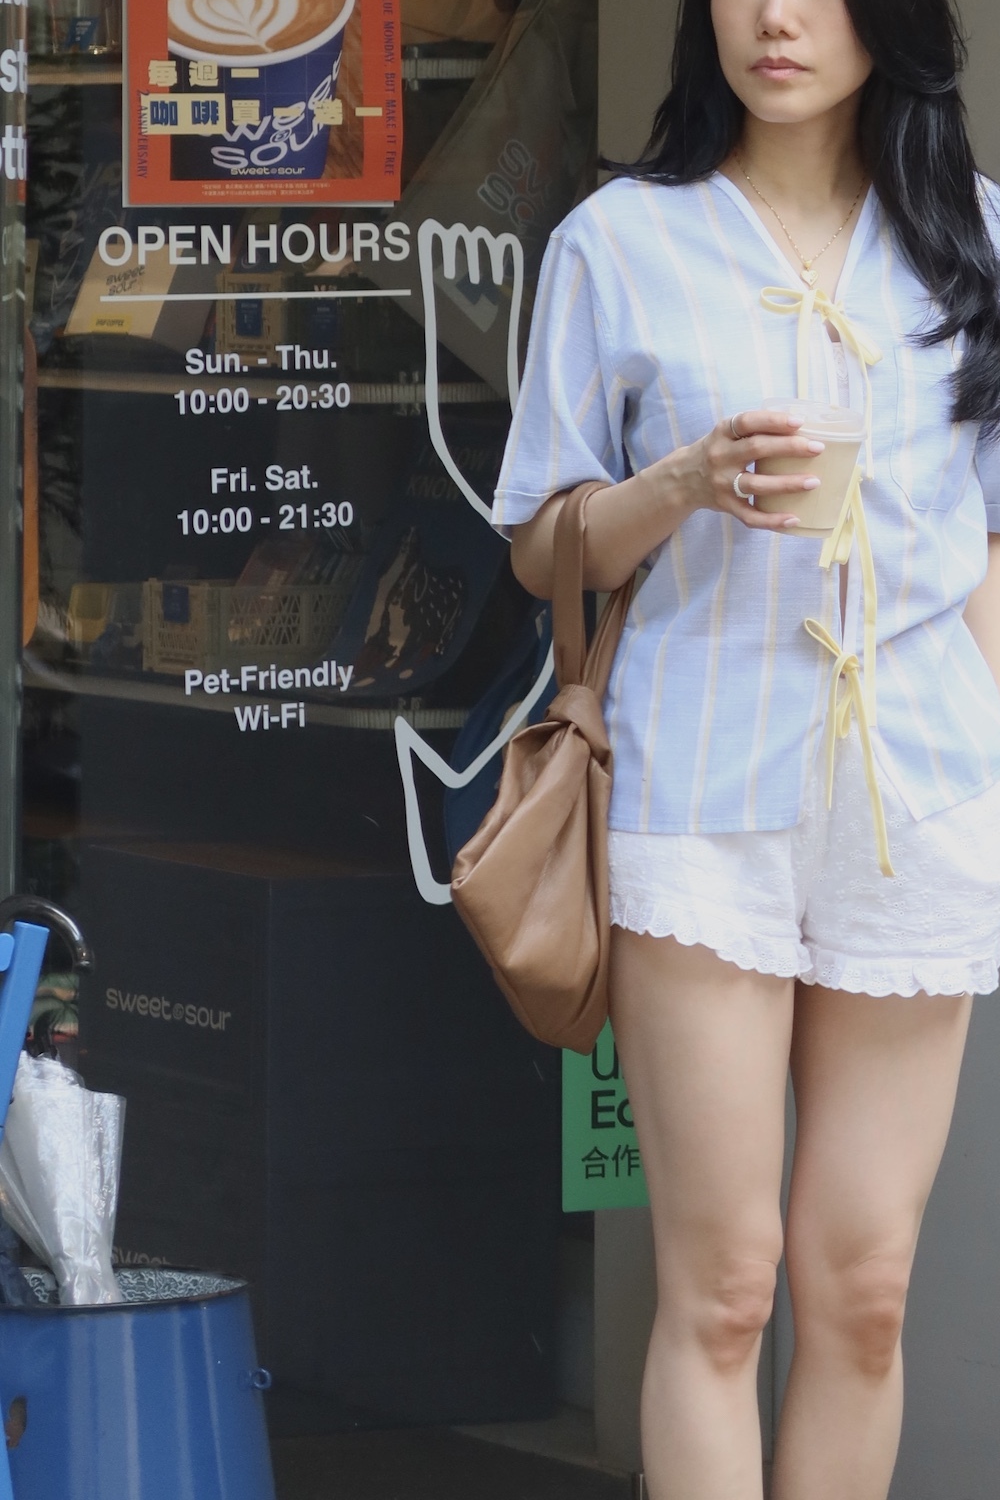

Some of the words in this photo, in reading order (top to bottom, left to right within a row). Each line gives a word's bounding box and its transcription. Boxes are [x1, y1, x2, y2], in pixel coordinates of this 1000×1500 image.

[385, 73, 396, 93] BUT
[386, 99, 397, 129] MAKE
[385, 152, 397, 177] FREE
[99, 224, 231, 267] OPEN
[248, 221, 411, 264] HOURS
[185, 348, 249, 375] Sun.
[275, 344, 337, 370] Thu.
[174, 387, 250, 415] 10:00
[276, 382, 351, 411] 20:30
[211, 467, 256, 494] Fri.
[265, 464, 318, 492] Sat.
[177, 506, 252, 536] 10:00
[278, 501, 354, 530] 21:30
[184, 660, 354, 696] Pet-Friendly
[233, 702, 305, 732] Wi-Fi
